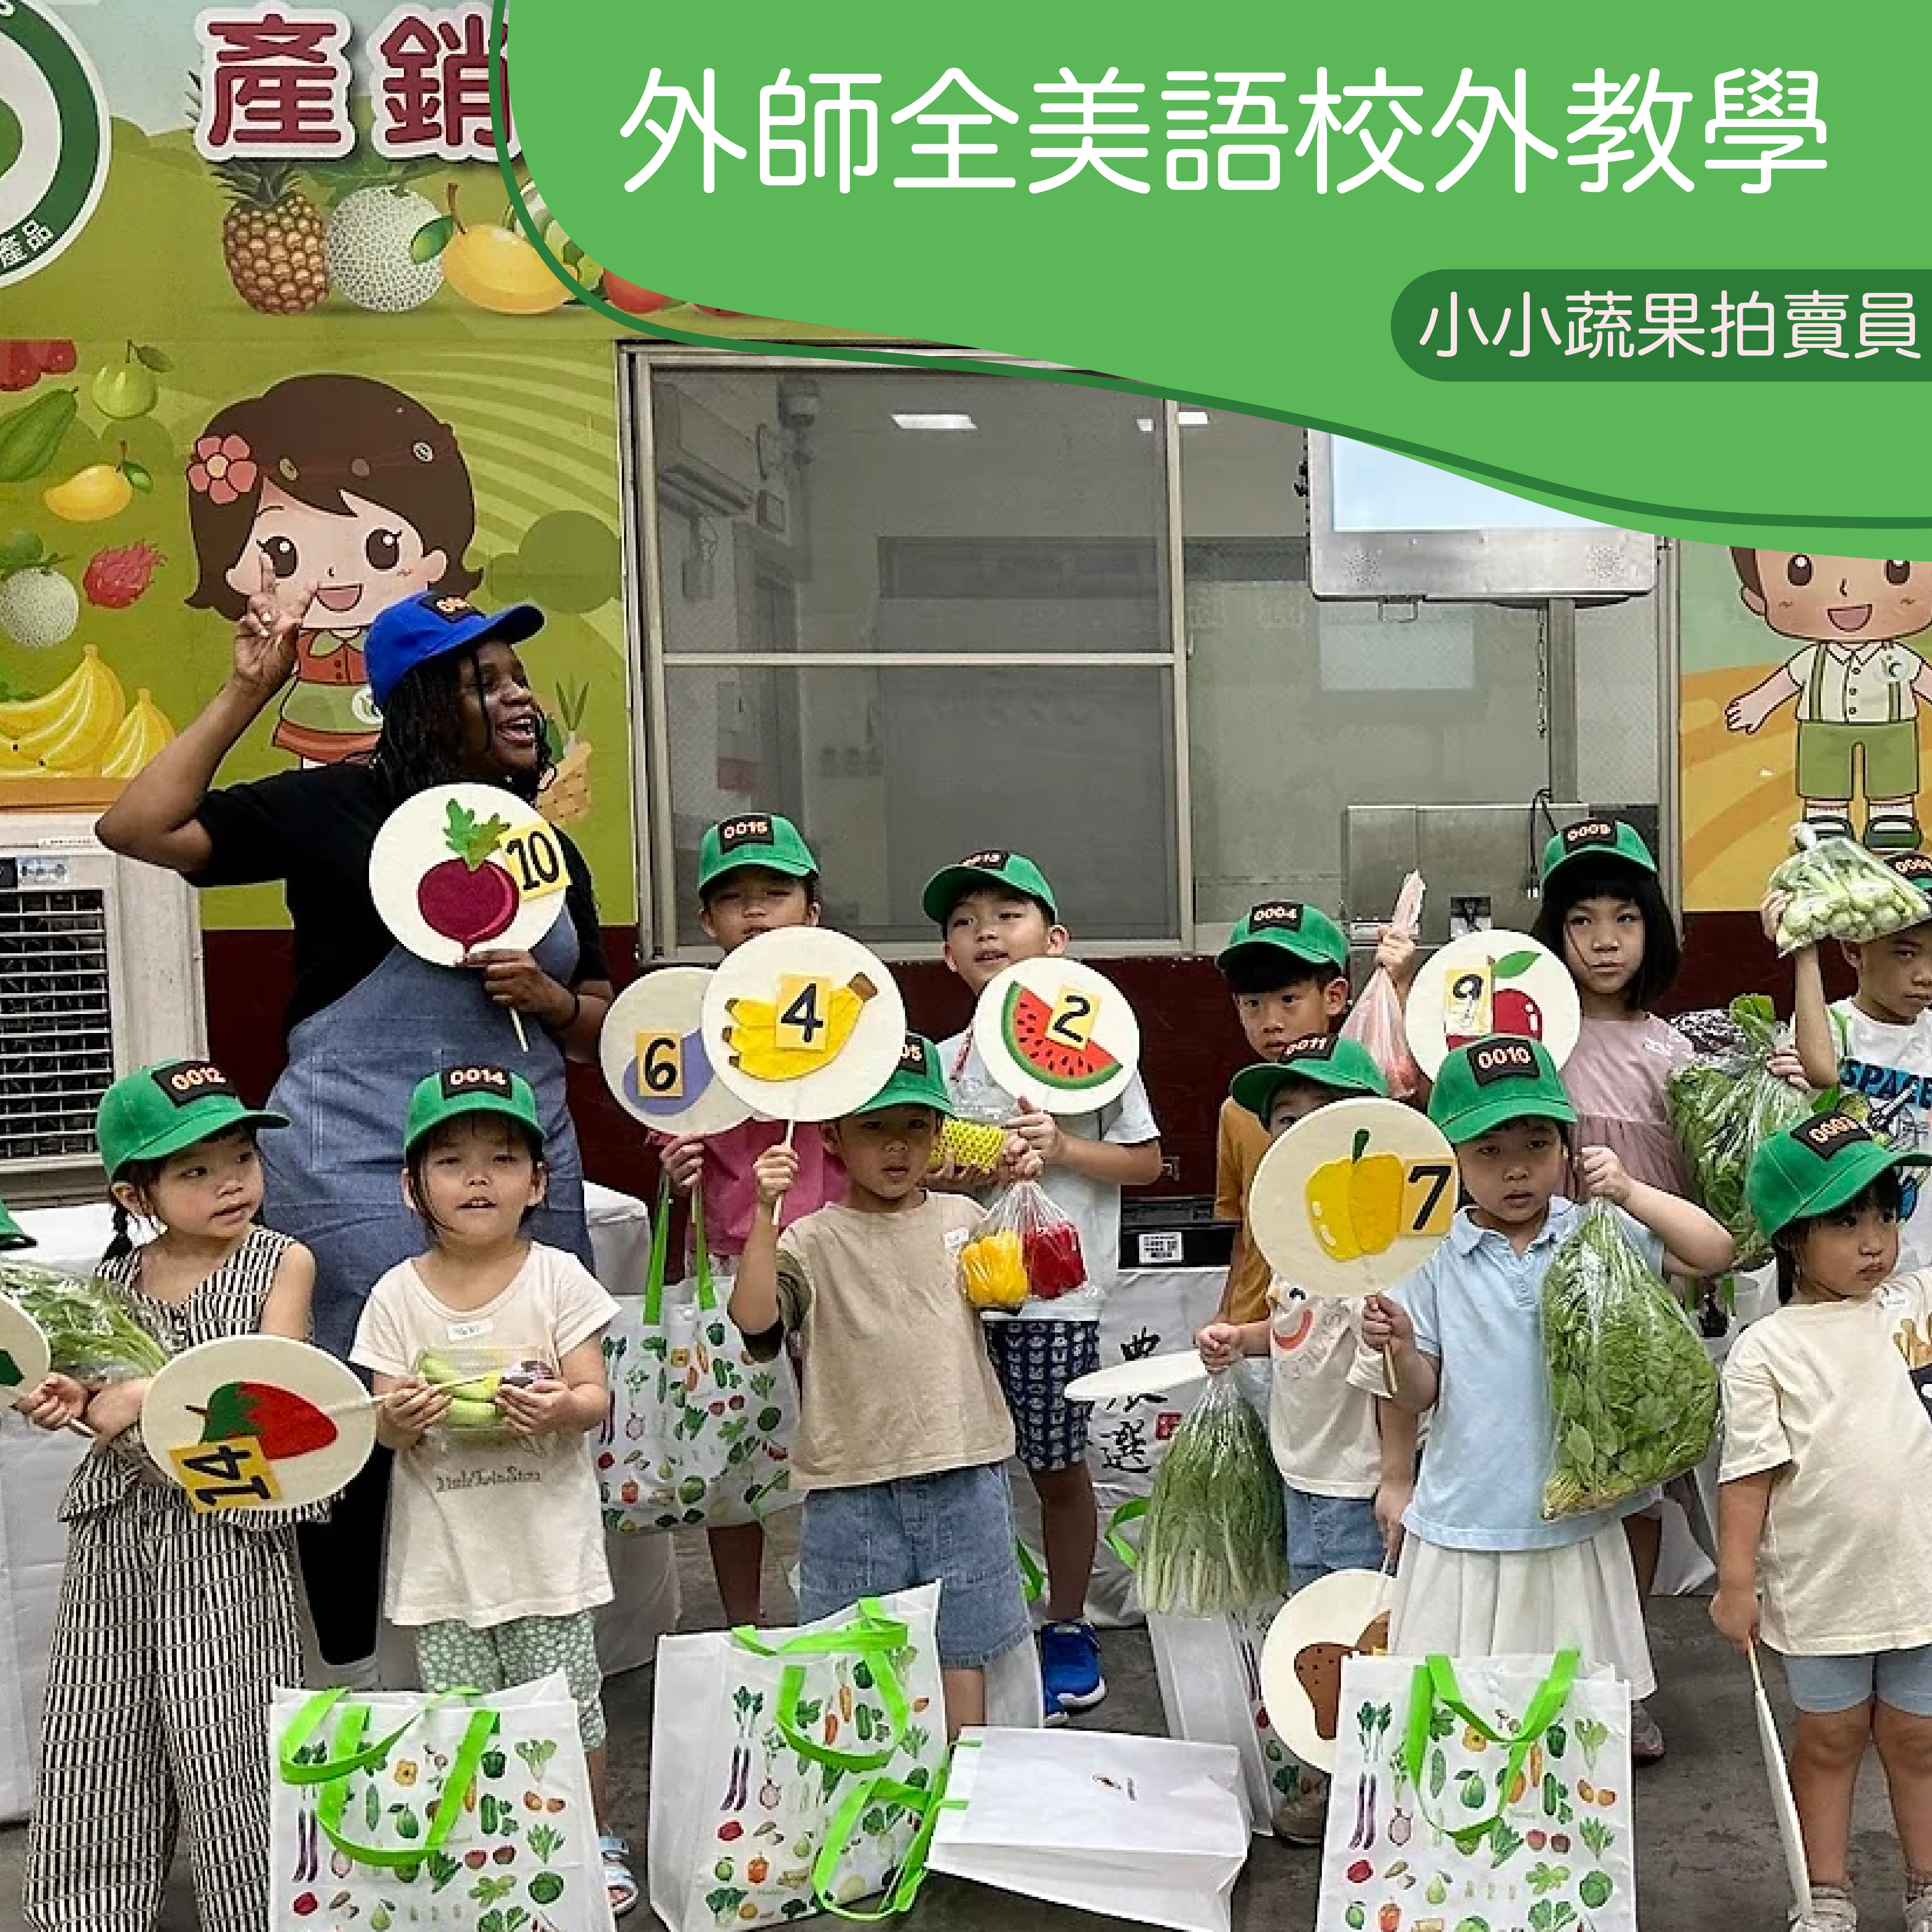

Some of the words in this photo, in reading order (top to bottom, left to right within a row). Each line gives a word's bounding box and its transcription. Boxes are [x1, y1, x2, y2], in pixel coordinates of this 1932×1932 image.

[507, 830, 560, 892] 10
[1253, 906, 1298, 922] 0004
[781, 983, 823, 1043] 4
[1053, 995, 1090, 1043] 2
[1453, 974, 1483, 1027] 9
[171, 1066, 226, 1091] 0012
[449, 1069, 506, 1087] 0014
[644, 1037, 676, 1093] 6
[1478, 1046, 1531, 1070] 0010
[1408, 1165, 1452, 1231] 7
[183, 1445, 273, 1505] 14
